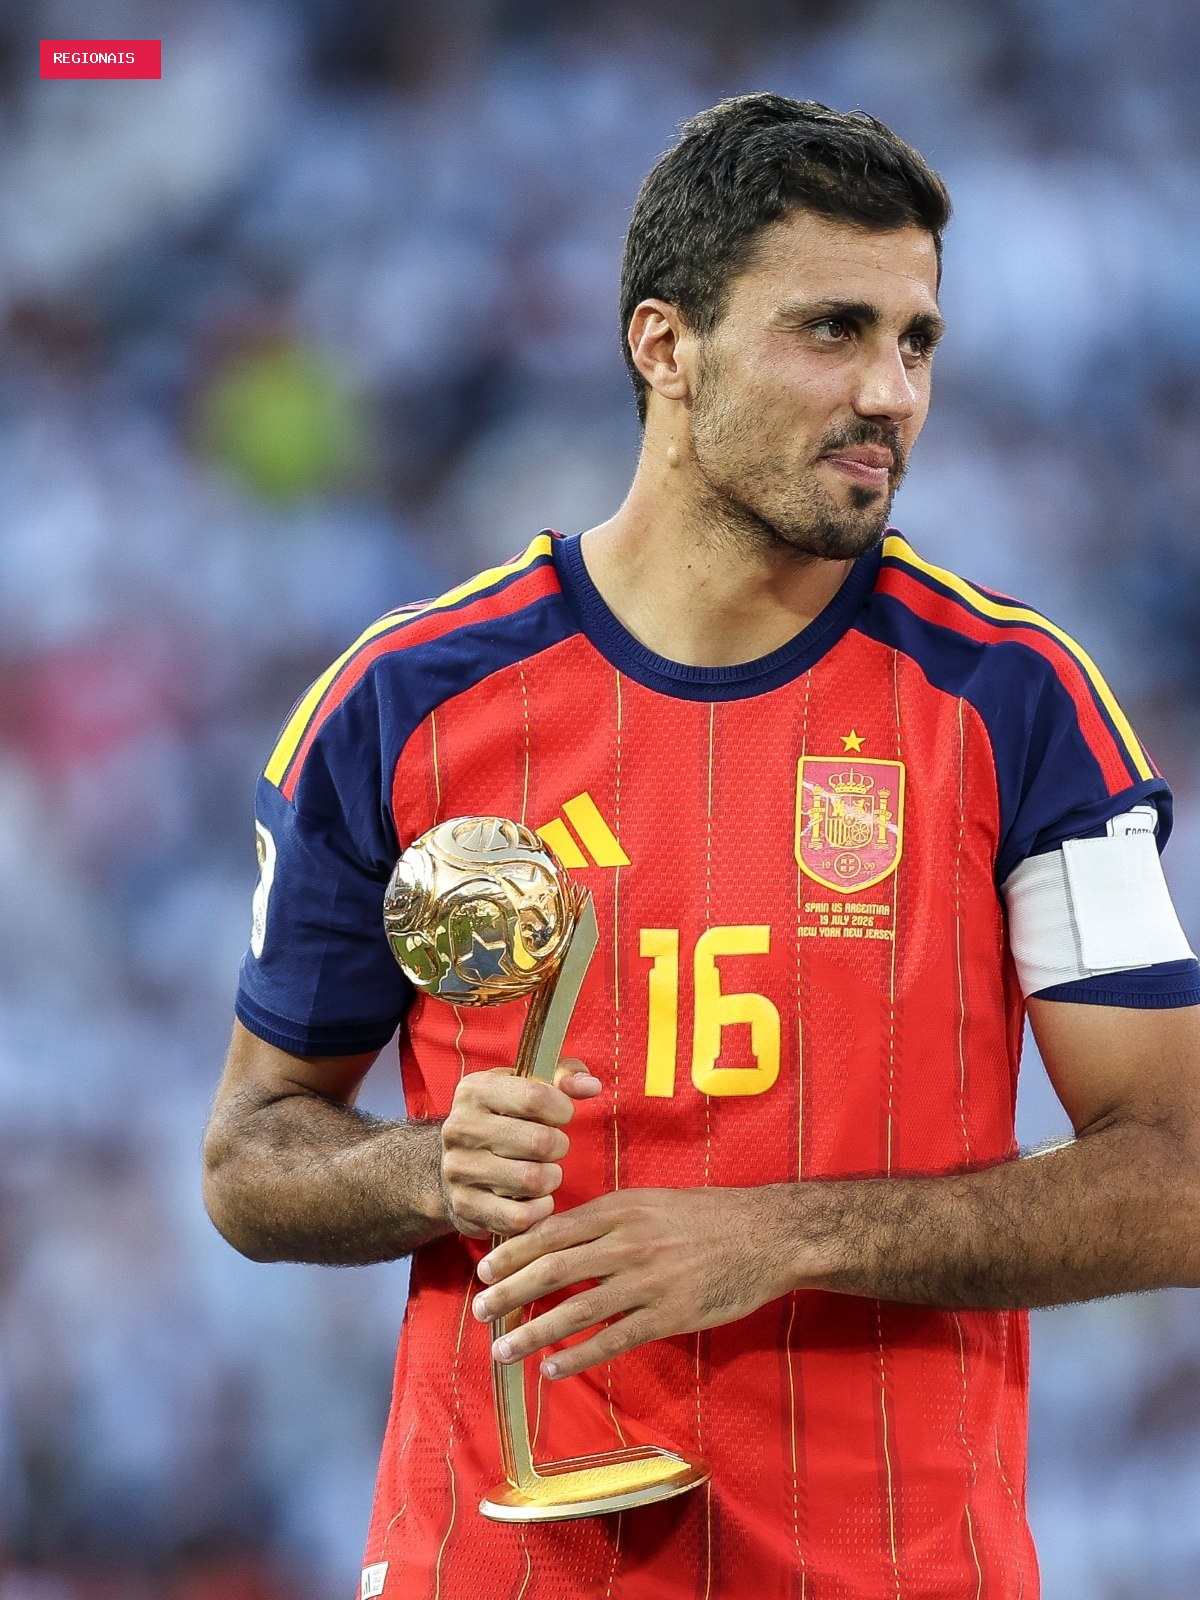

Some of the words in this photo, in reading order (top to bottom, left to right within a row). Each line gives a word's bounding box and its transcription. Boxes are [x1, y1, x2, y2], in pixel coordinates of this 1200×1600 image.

[804, 902, 829, 913] SPAIN
[845, 903, 890, 916] ARGENTINA
[820, 915, 829, 925] 19
[831, 915, 850, 926] JULY
[852, 916, 874, 927] 2026
[798, 927, 817, 938] NEW
[819, 927, 841, 938] YORK
[843, 928, 863, 938] NEW
[864, 929, 896, 941] JERSEY
[639, 924, 781, 1098] 16
